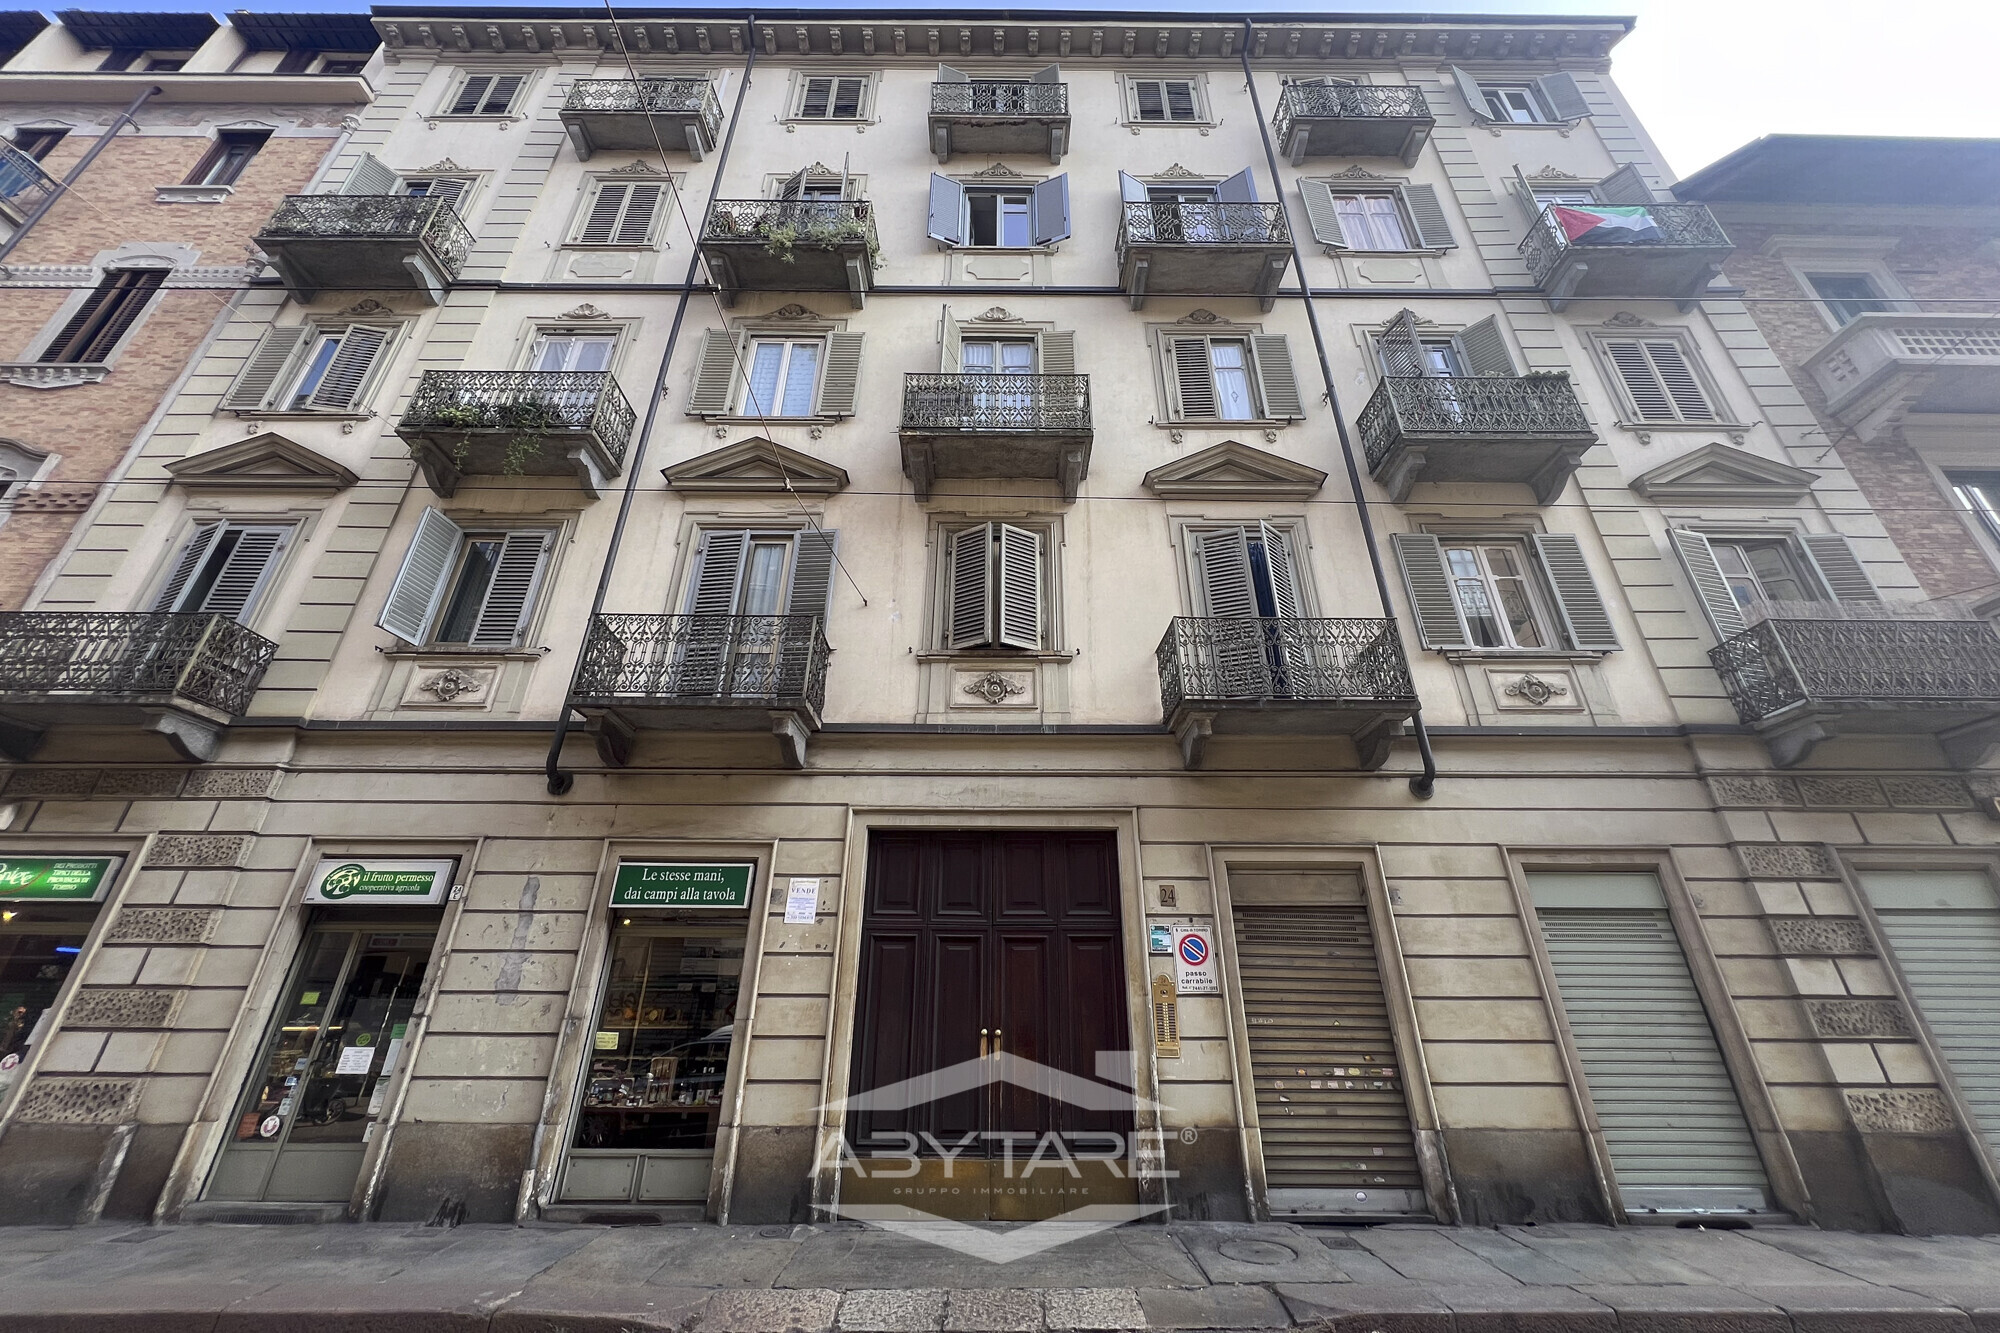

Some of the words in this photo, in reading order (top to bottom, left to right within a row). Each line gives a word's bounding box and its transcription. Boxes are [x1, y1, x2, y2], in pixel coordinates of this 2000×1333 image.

[363, 872, 370, 881] il
[370, 872, 394, 883] frutto
[395, 875, 433, 884] permesso
[642, 868, 658, 881] Le
[660, 870, 691, 881] stesse
[693, 868, 725, 883] mani,
[359, 884, 395, 892] cooperativa
[395, 884, 420, 893] agricola
[624, 886, 642, 900] dai
[643, 886, 678, 902] campi
[680, 887, 700, 900] alla
[703, 887, 736, 900] tavola
[1161, 889, 1175, 903] 24
